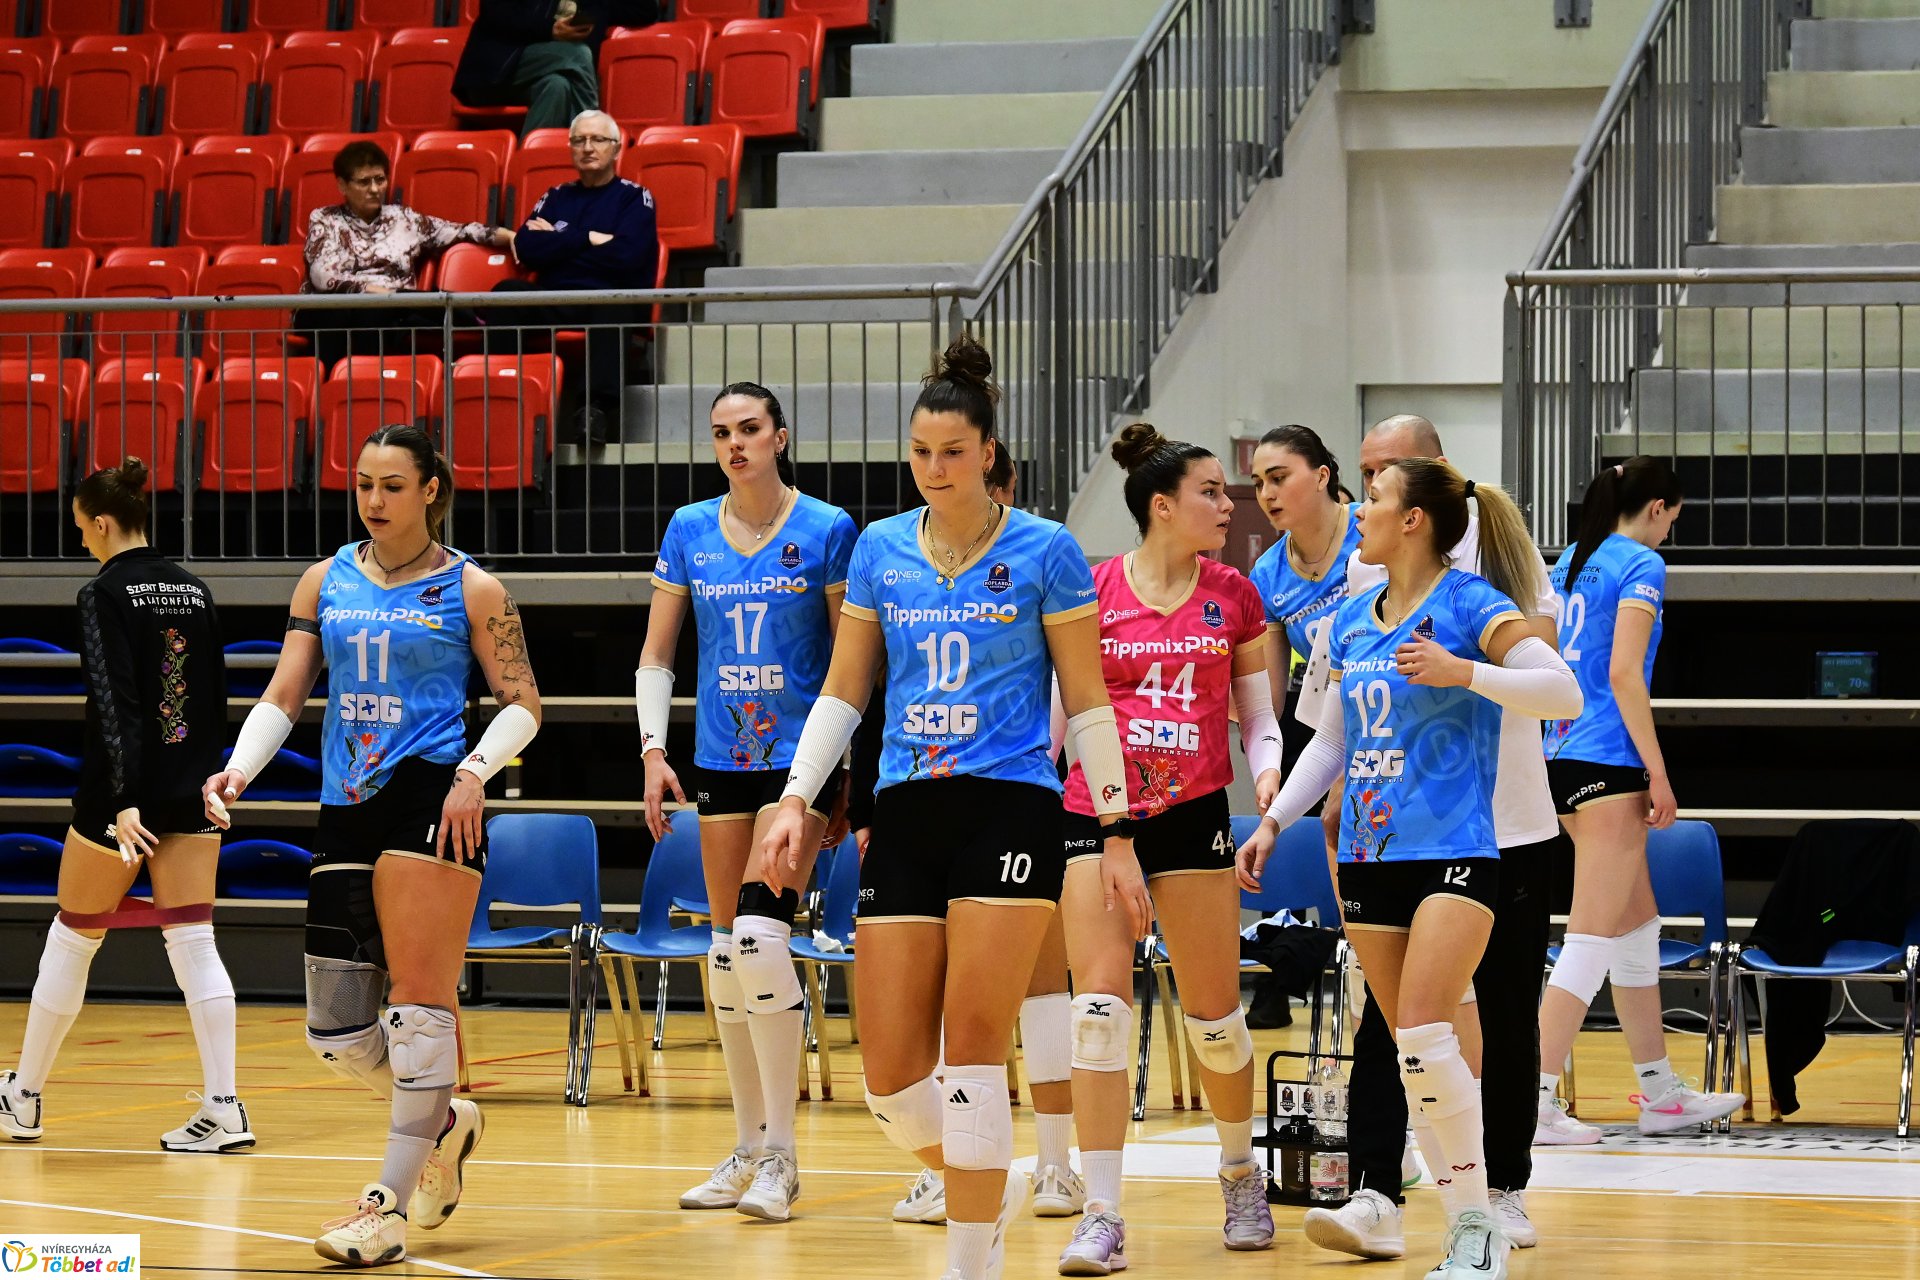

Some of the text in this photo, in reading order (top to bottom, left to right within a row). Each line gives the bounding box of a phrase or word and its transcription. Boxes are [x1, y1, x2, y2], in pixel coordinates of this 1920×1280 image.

[706, 552, 725, 560] NEO
[126, 583, 205, 597] SZENT BENEDEK
[693, 576, 809, 601] TippmixPRO
[897, 570, 922, 579] NEO
[724, 602, 769, 655] 17
[882, 602, 1019, 628] TippmixPRO
[346, 628, 391, 684] 11
[916, 631, 970, 693] 10
[1100, 635, 1229, 660] TippmixPRO
[718, 664, 785, 691] SDG
[1135, 661, 1198, 713] 44
[340, 692, 403, 724] SDG
[902, 703, 978, 735] SDG
[1348, 679, 1393, 738] 12
[1126, 718, 1200, 752] SDG
[1348, 749, 1406, 779] SDG
[999, 851, 1033, 884] 10
[1443, 866, 1472, 887] 12
